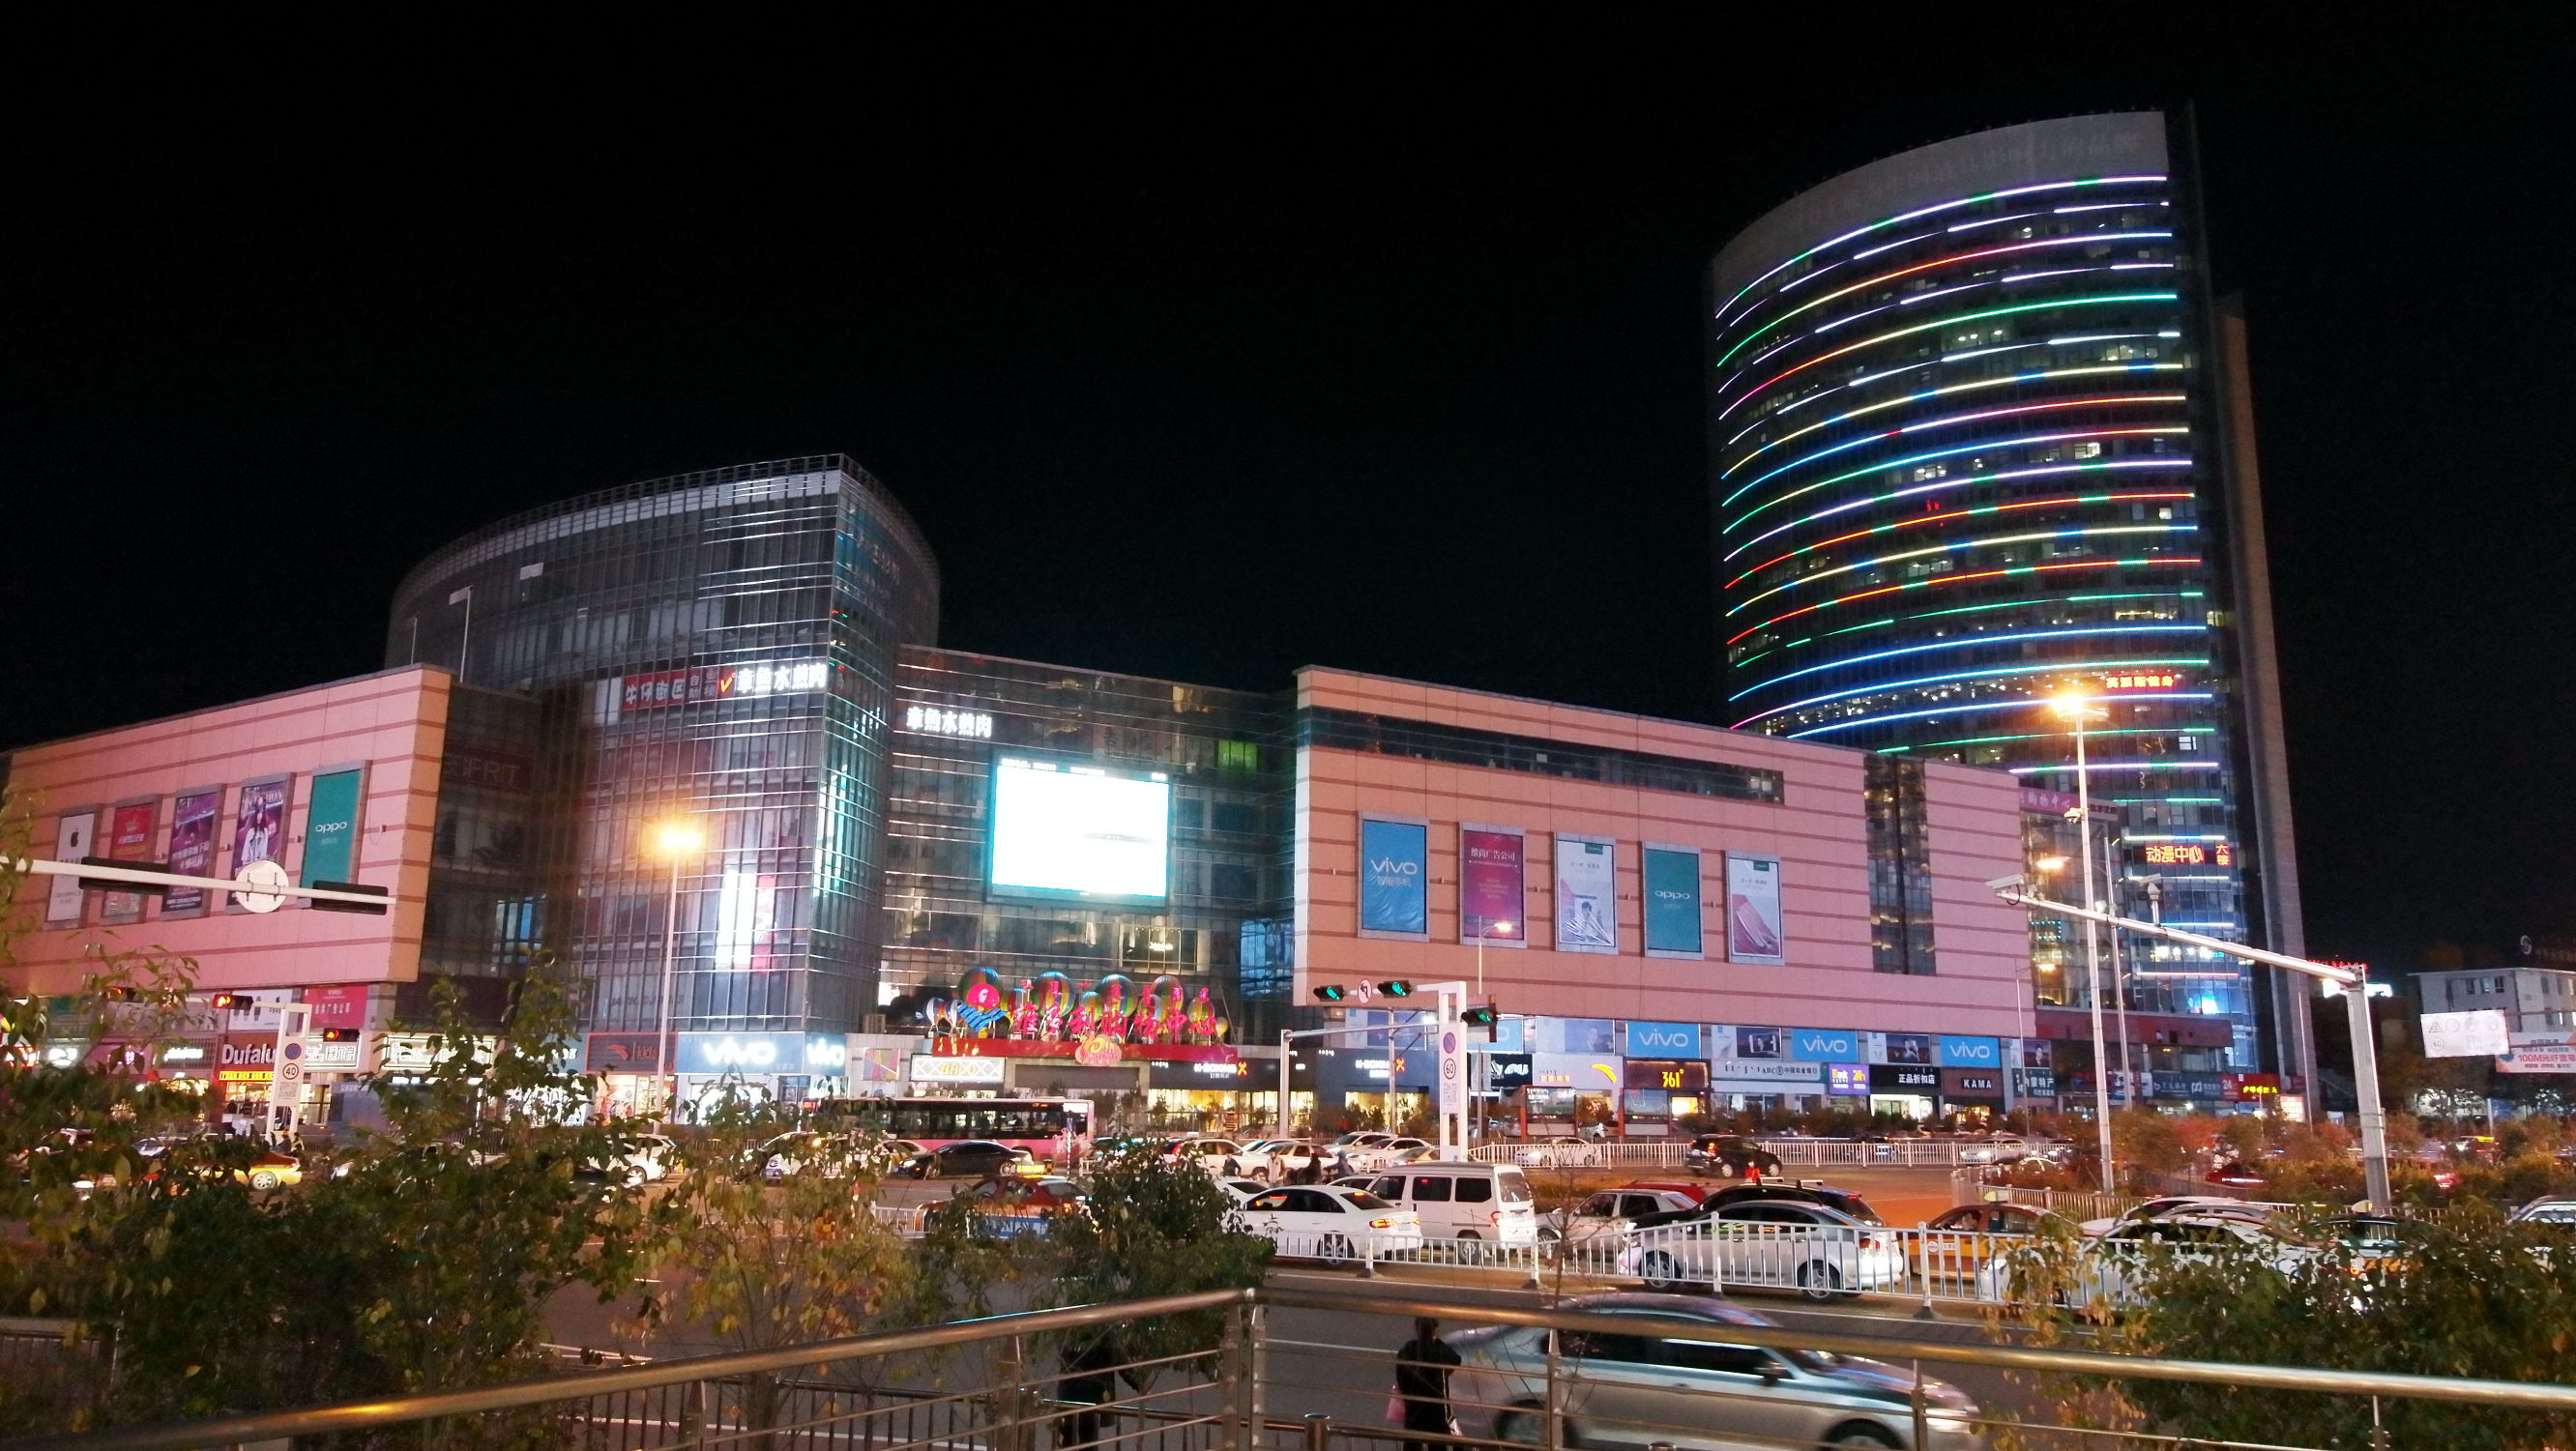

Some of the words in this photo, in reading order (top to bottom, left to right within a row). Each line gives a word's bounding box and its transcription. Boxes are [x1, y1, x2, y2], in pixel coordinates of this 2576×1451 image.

[2146, 845, 2205, 863] 动漫中心
[1370, 856, 1418, 876] vivo
[1639, 1028, 1689, 1048] vivo
[1802, 1034, 1848, 1054] vivo
[704, 1037, 776, 1064] vivo
[1949, 1041, 1990, 1059] vivo
[285, 1067, 296, 1076] 40
[1898, 1073, 1936, 1085] 正品折扣店
[1963, 1079, 1992, 1089] KAMA
